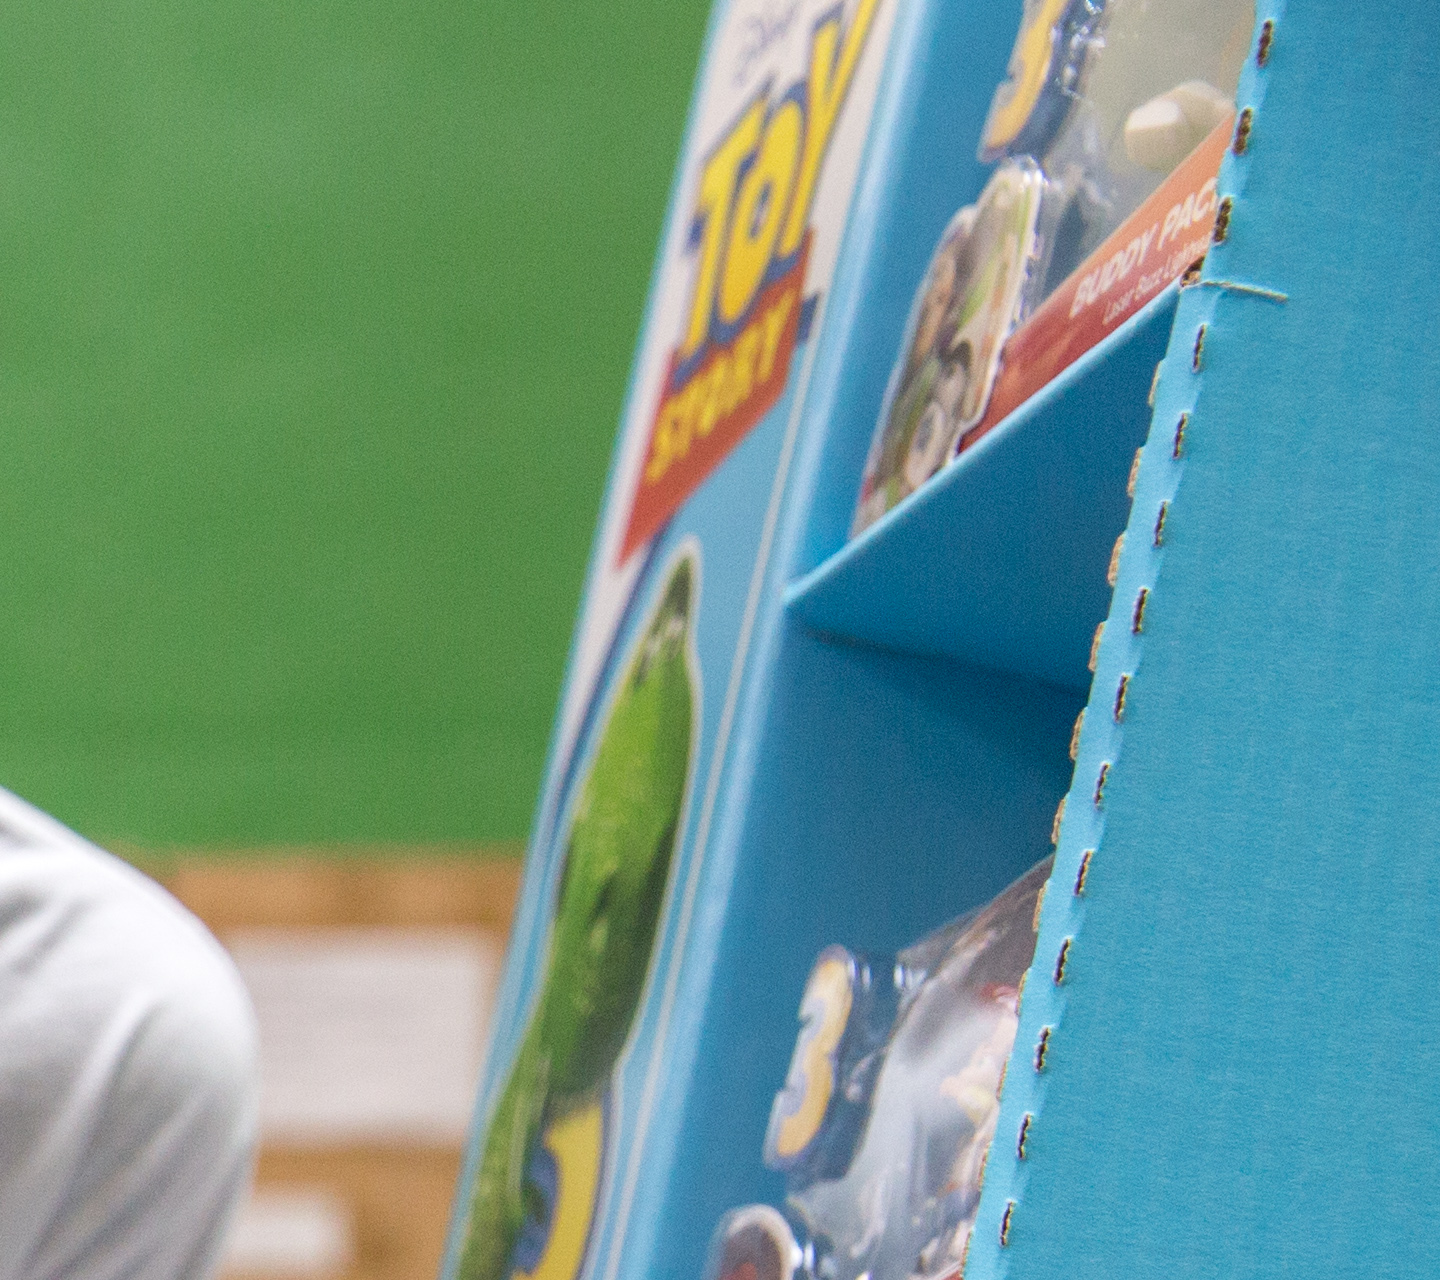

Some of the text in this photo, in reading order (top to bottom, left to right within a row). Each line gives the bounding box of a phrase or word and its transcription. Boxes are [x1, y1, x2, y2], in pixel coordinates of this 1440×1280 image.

[683, 0, 876, 360] TOY
[1069, 222, 1159, 318] BUDDY
[645, 286, 797, 485] STORY
[774, 950, 854, 1166] 3
